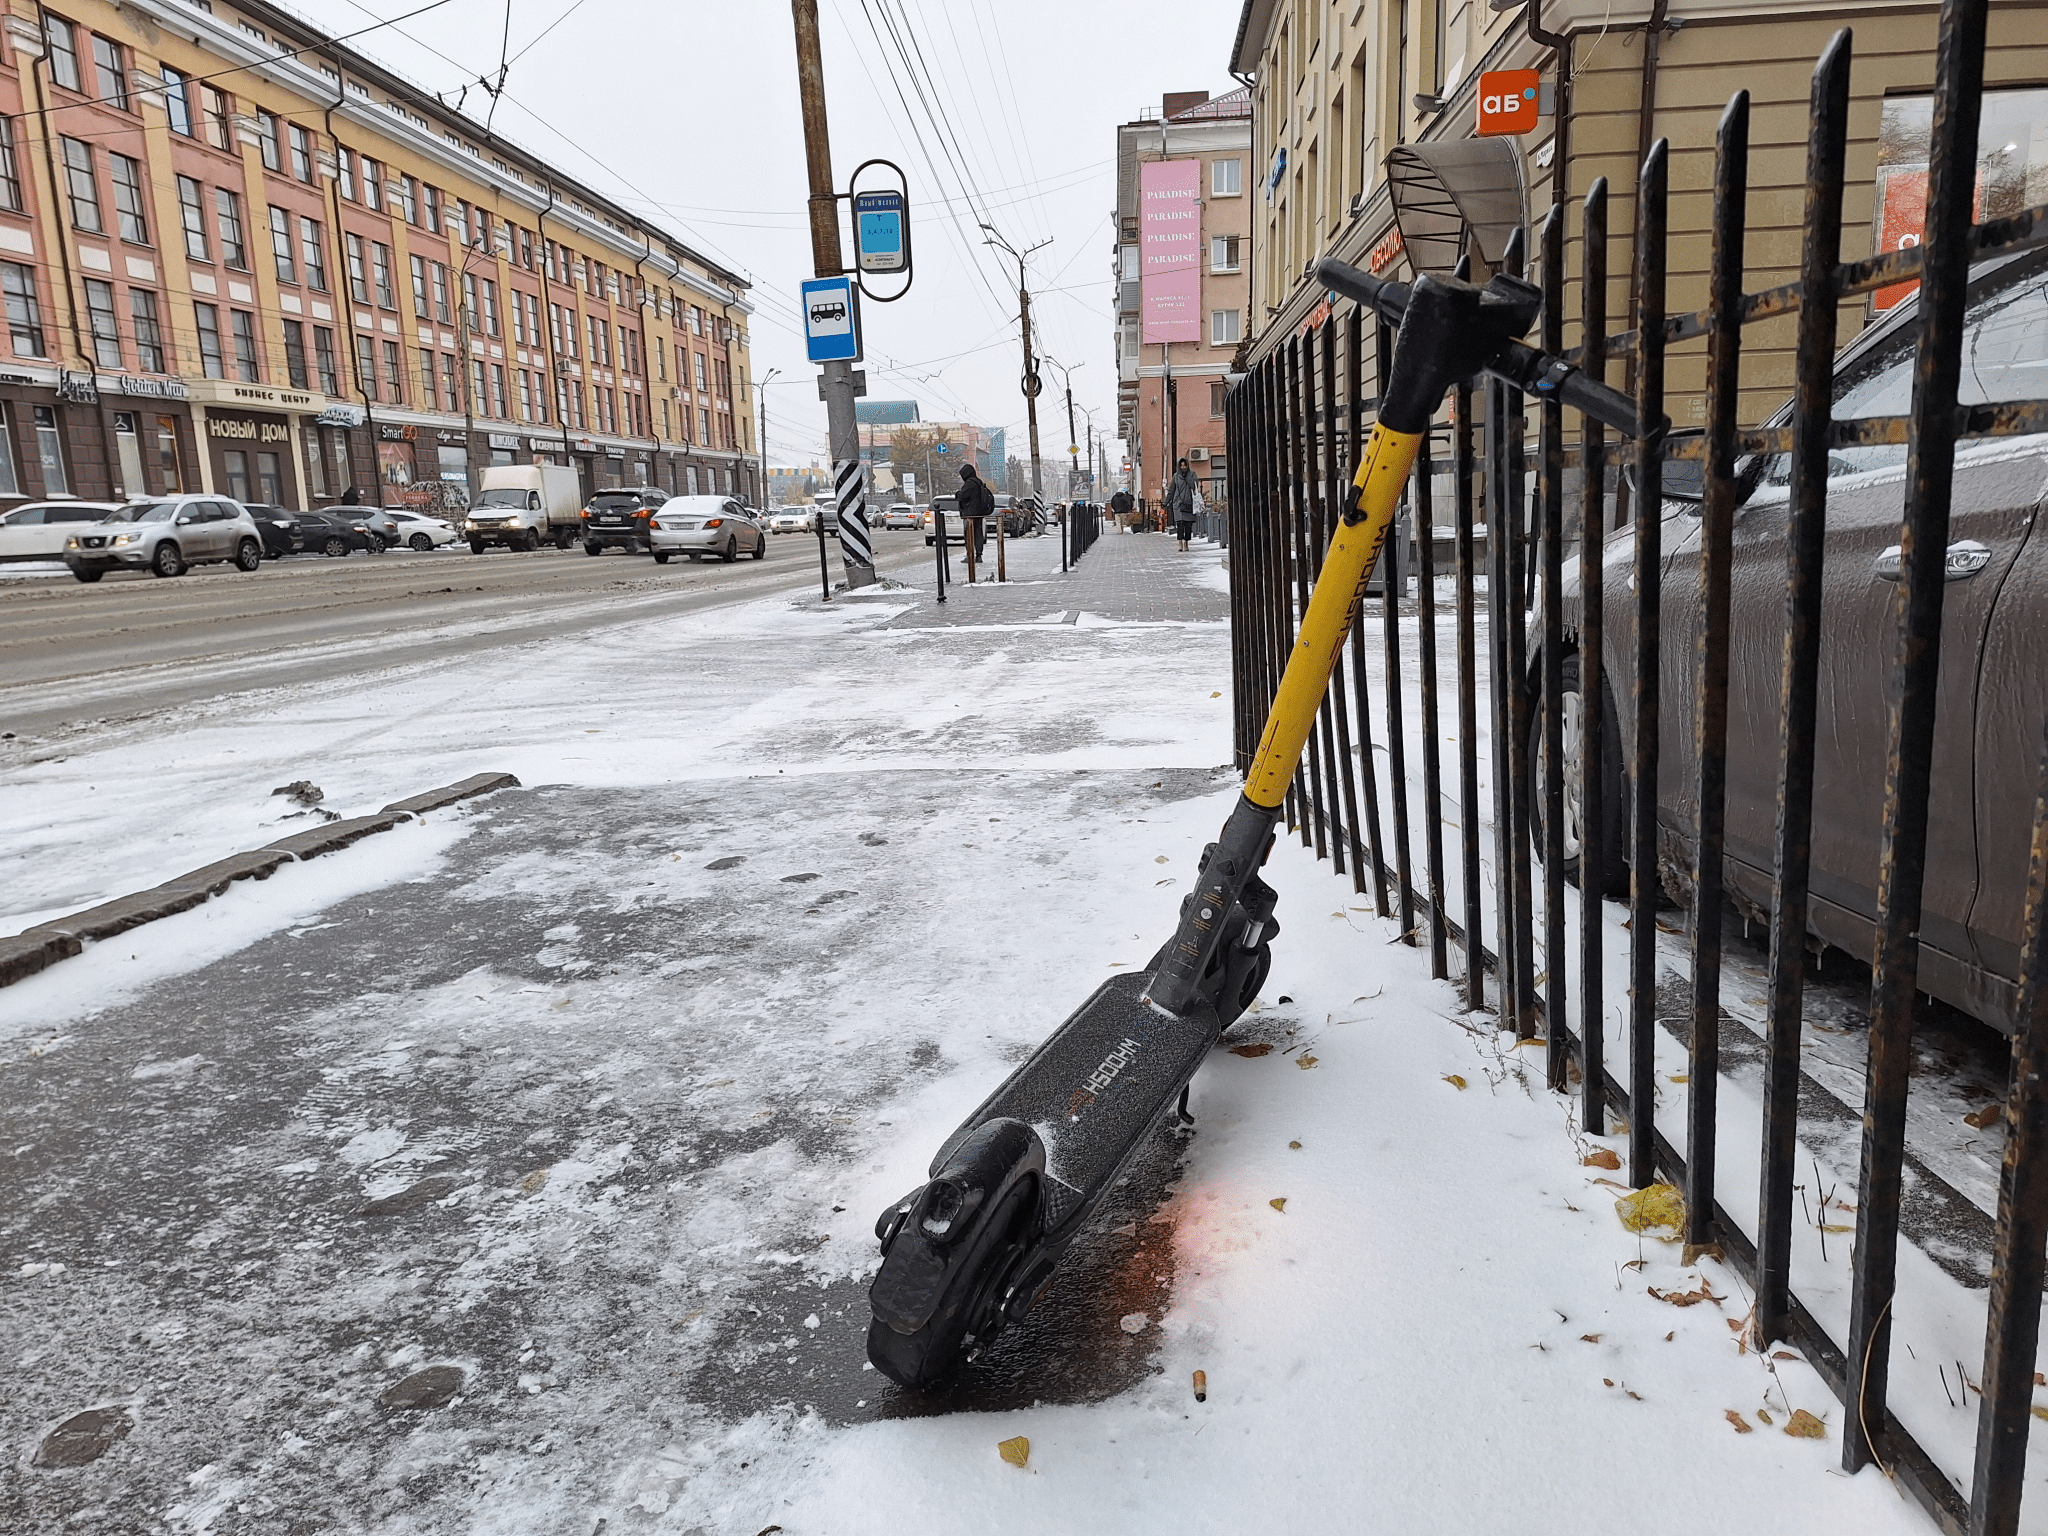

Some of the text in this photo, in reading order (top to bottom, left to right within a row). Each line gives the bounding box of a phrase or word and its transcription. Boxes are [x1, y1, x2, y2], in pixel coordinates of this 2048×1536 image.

[1147, 189, 1195, 201] PARADISE
[1147, 210, 1195, 222] PARADISE
[1147, 232, 1195, 243] PARADISE
[1147, 253, 1195, 265] PARADISE
[234, 387, 311, 405] БИЗНЕС ЦЕНТР
[209, 418, 289, 444] НОВЫЙ ДОМ
[1340, 523, 1389, 633] WHOOSH
[1081, 1038, 1142, 1096] WHOOSH
